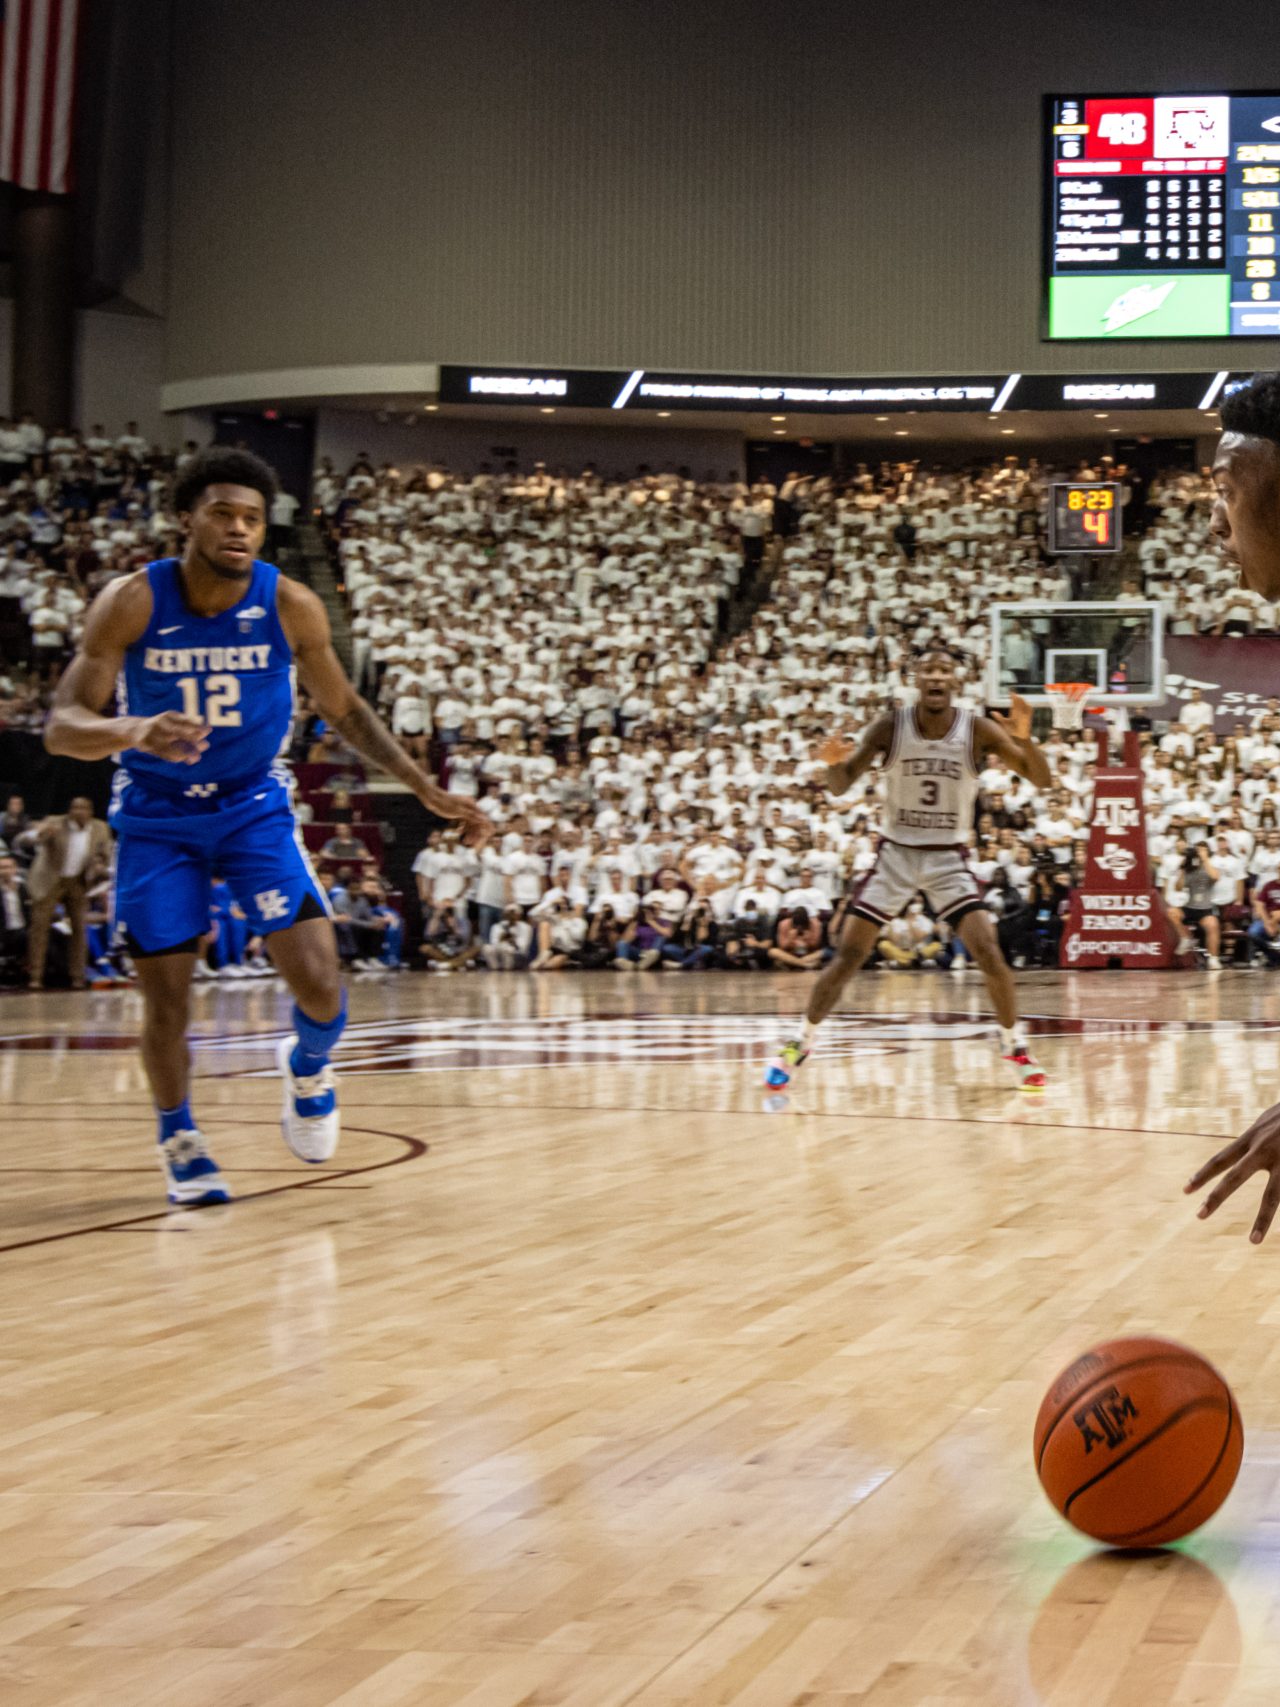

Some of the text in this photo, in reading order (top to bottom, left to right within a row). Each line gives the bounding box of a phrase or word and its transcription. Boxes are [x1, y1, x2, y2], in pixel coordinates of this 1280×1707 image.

[1097, 113, 1147, 144] 48
[1068, 490, 1113, 511] 8:23
[1083, 513, 1109, 543] 4
[144, 645, 271, 674] KENTUCKY
[176, 673, 242, 728] 12
[920, 780, 940, 806] 3
[1080, 895, 1151, 910] WELLS
[1081, 915, 1152, 930] FARGO
